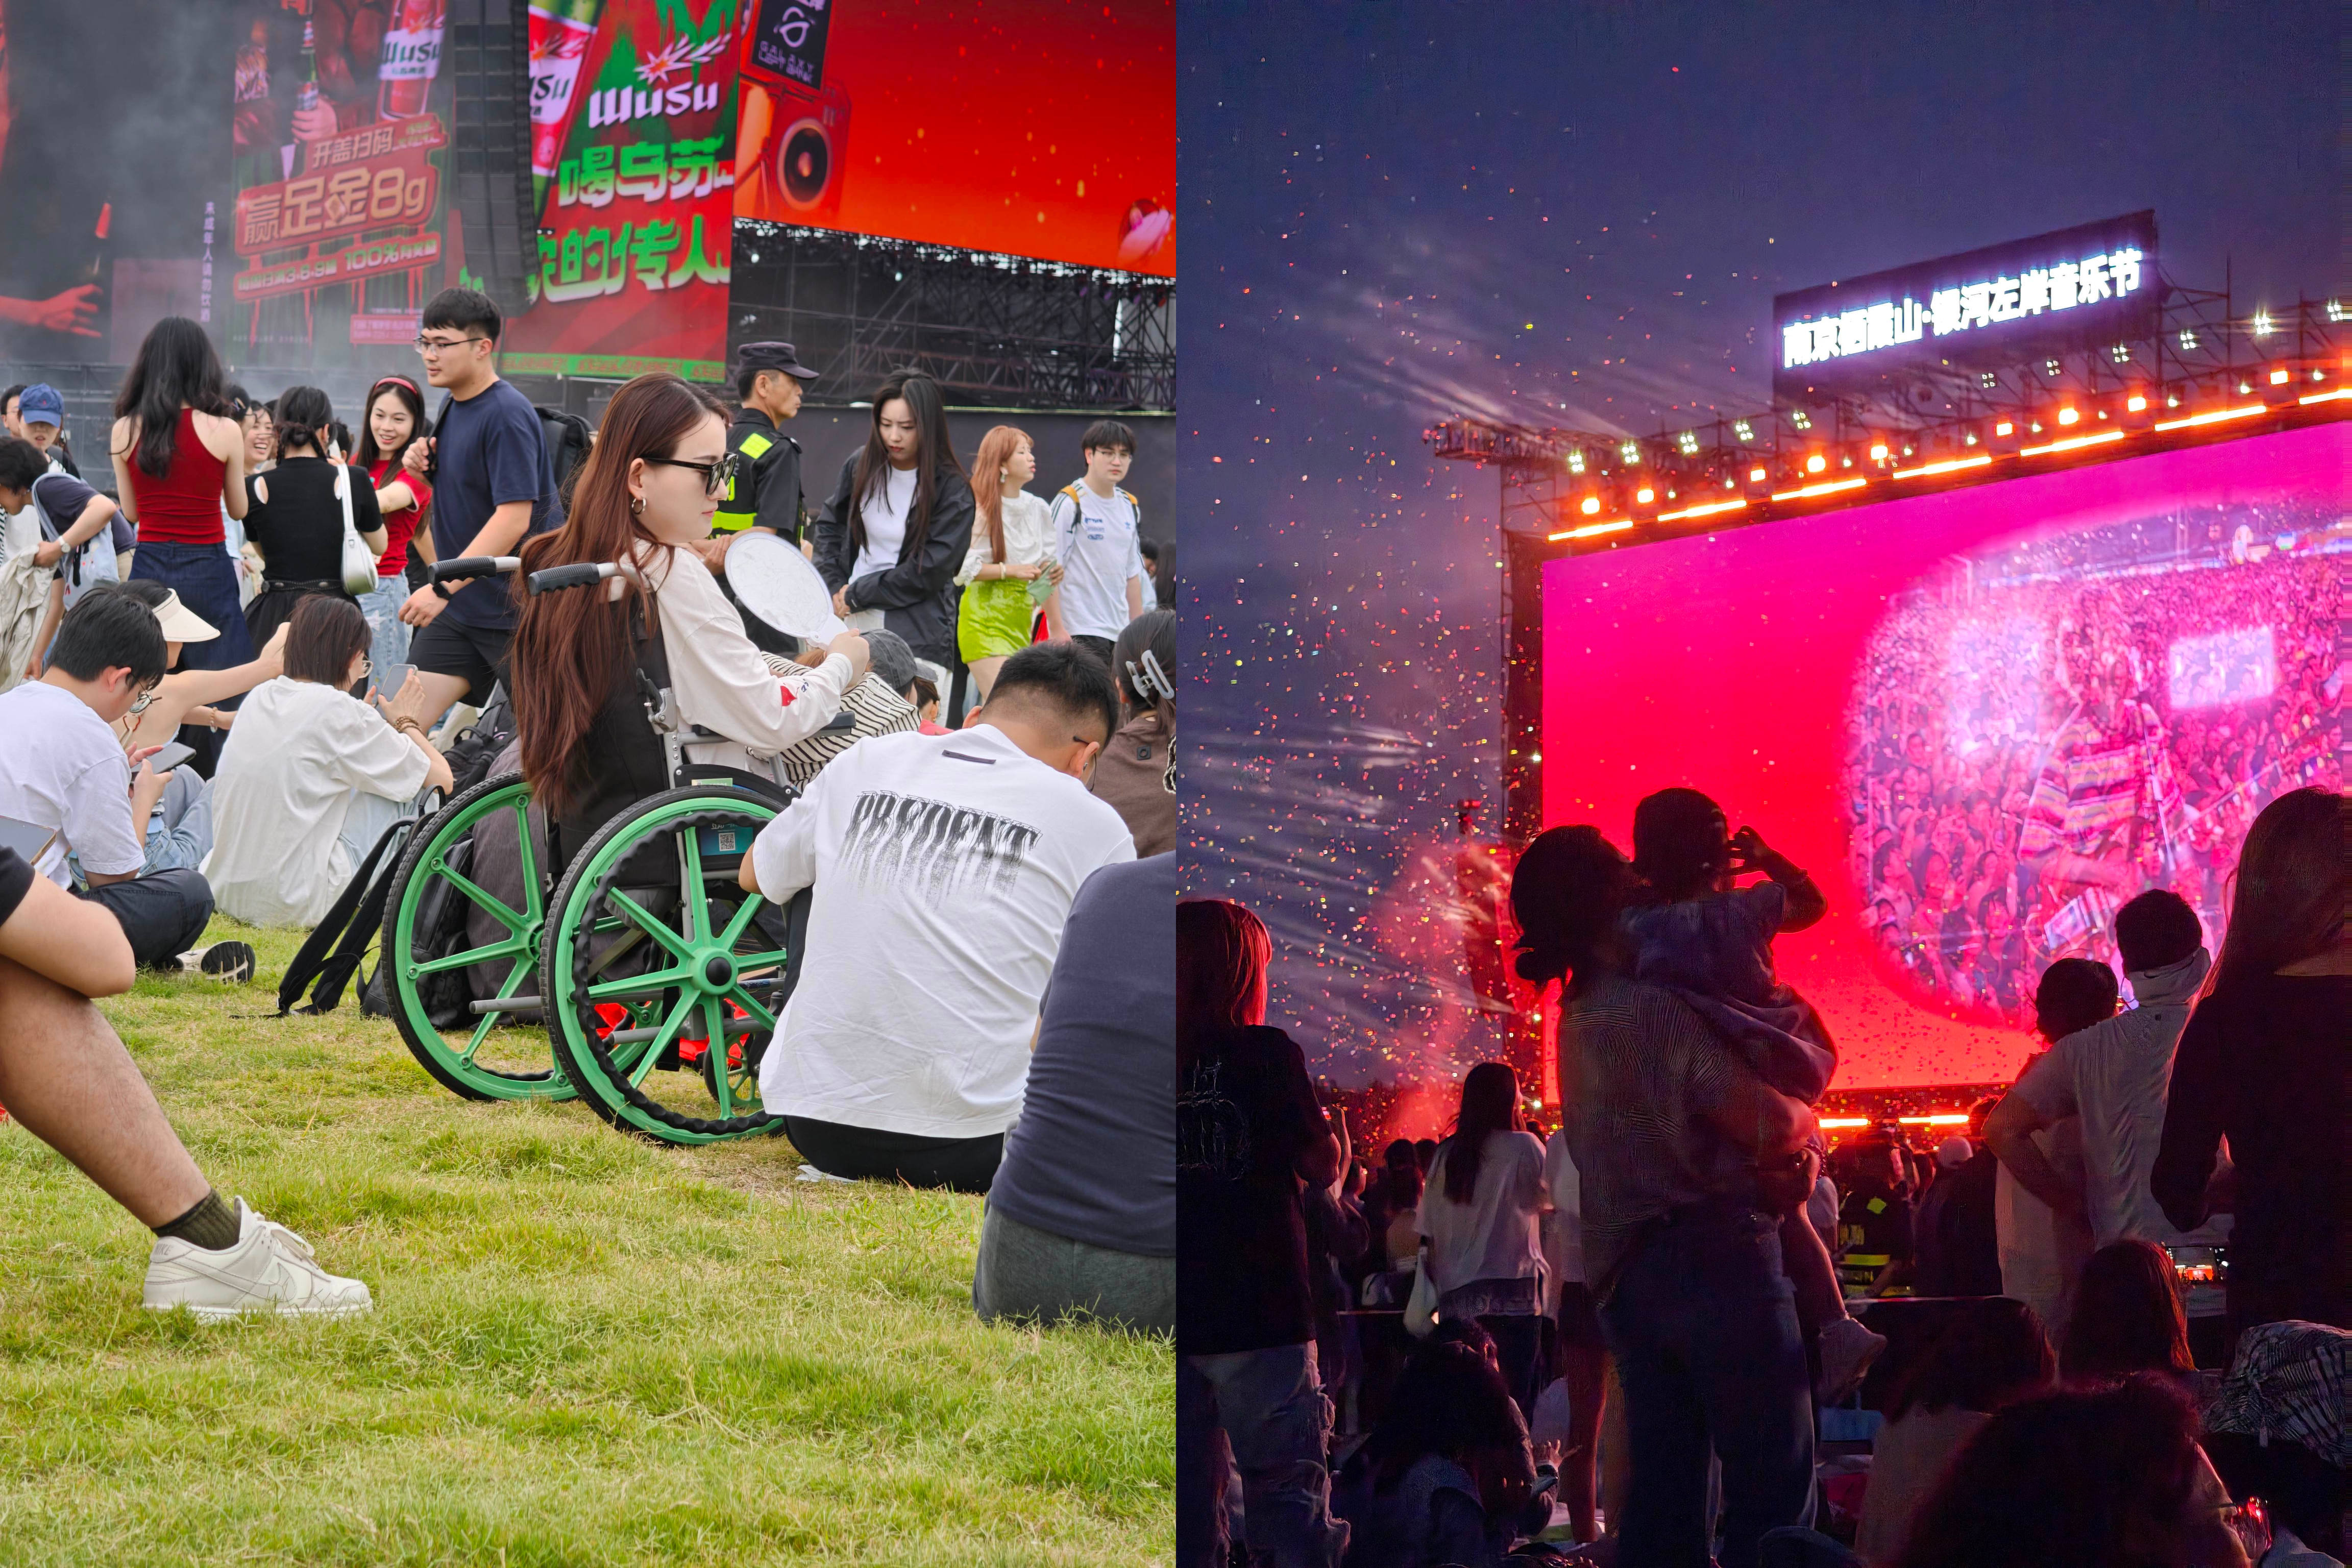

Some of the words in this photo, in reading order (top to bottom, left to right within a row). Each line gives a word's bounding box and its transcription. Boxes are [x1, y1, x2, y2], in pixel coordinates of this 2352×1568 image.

[312, 127, 394, 169] 开盖扫码
[558, 134, 734, 208] 喝乌苏
[243, 166, 428, 246] 赢足金8g
[459, 214, 731, 304] 的传人
